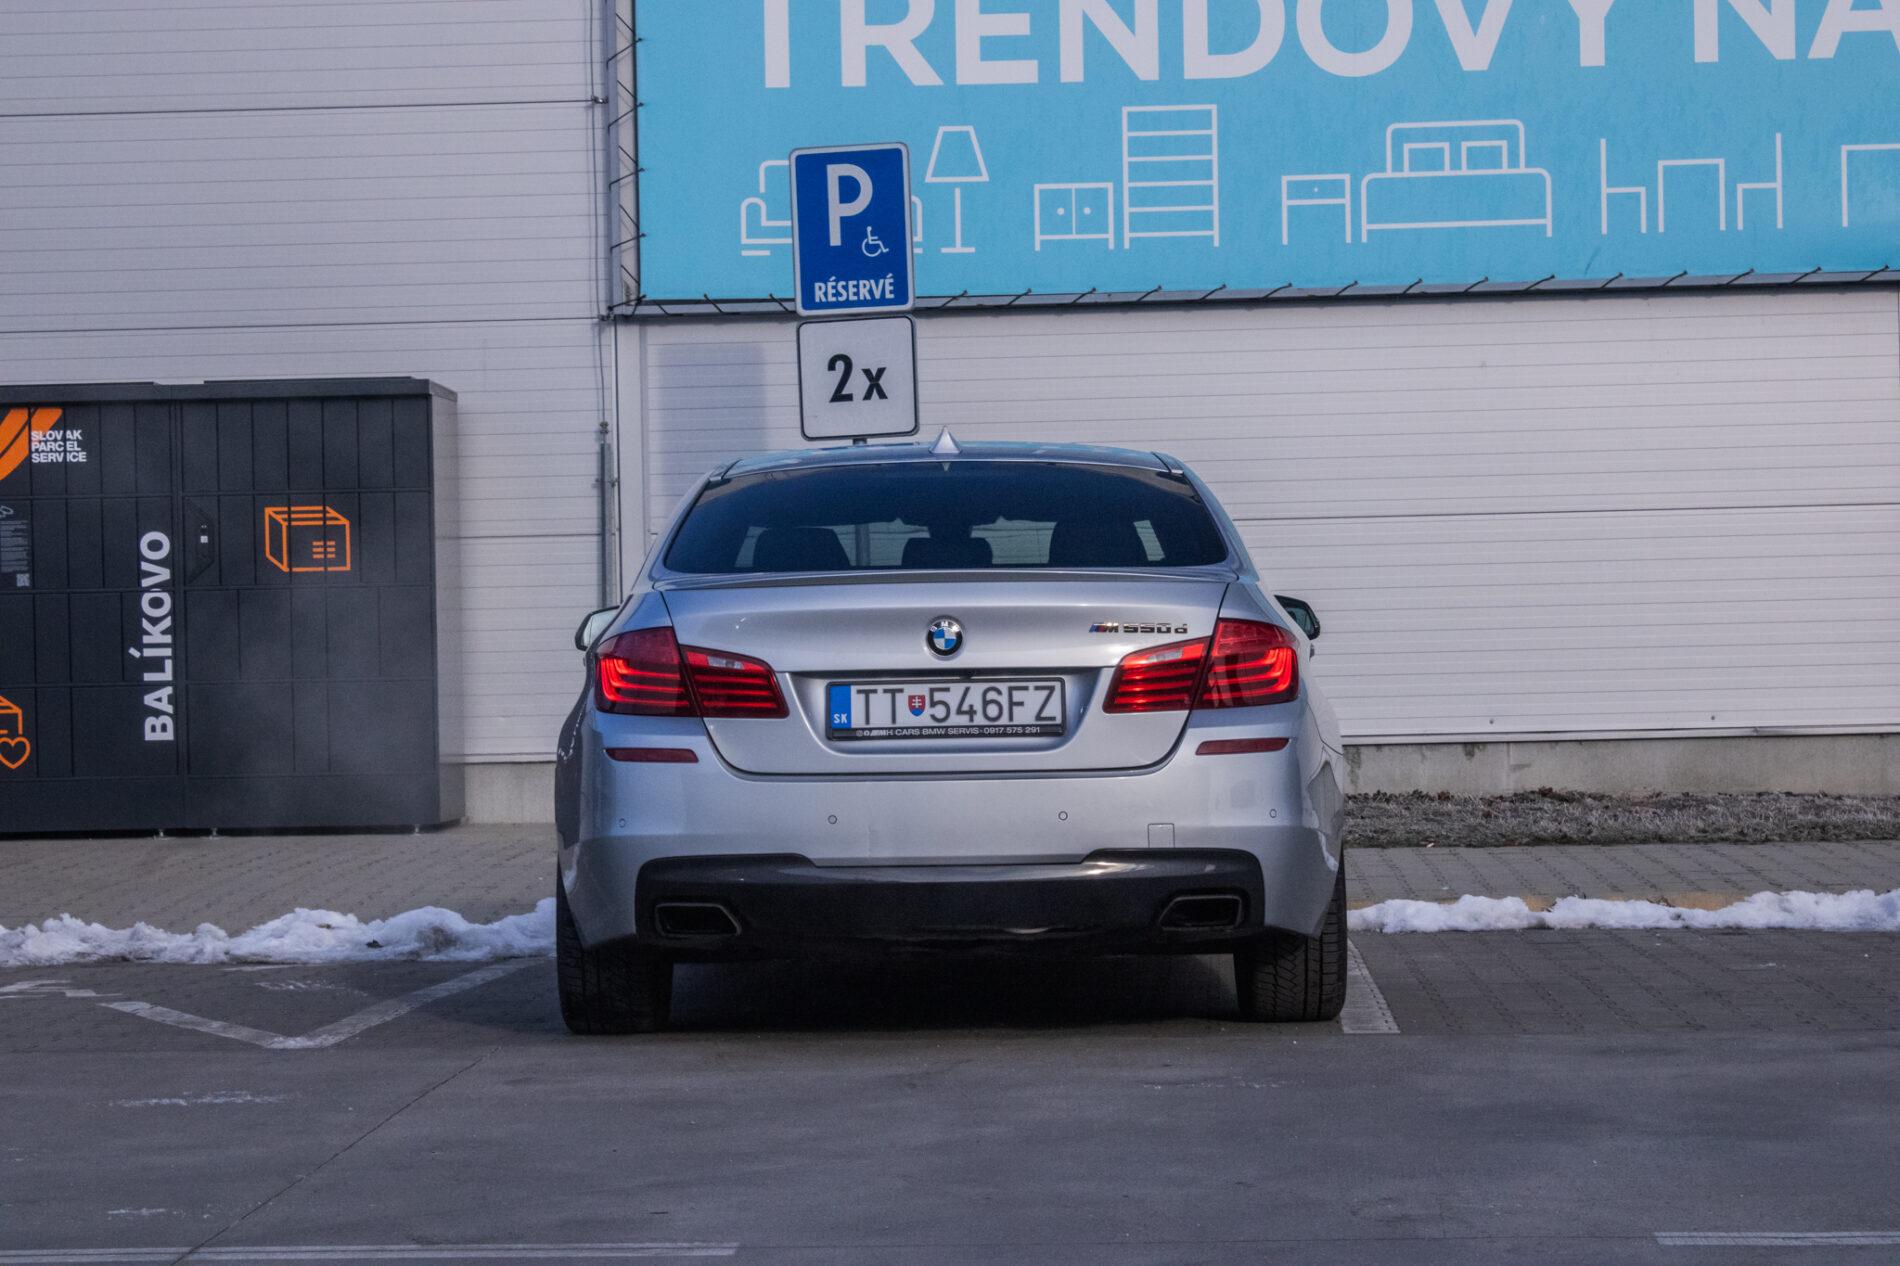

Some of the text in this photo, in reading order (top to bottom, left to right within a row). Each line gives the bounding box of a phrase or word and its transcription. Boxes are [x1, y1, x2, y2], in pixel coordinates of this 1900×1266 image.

[826, 163, 874, 247] P
[813, 273, 896, 303] RÉSERVÉ
[31, 430, 83, 441] SLOVAK
[31, 441, 82, 452] PARCEL
[31, 451, 88, 463] SERVICE
[128, 531, 175, 741] BALÍKOVO
[833, 713, 848, 724] SK
[895, 728, 920, 736] CARS
[922, 728, 946, 736] BMW
